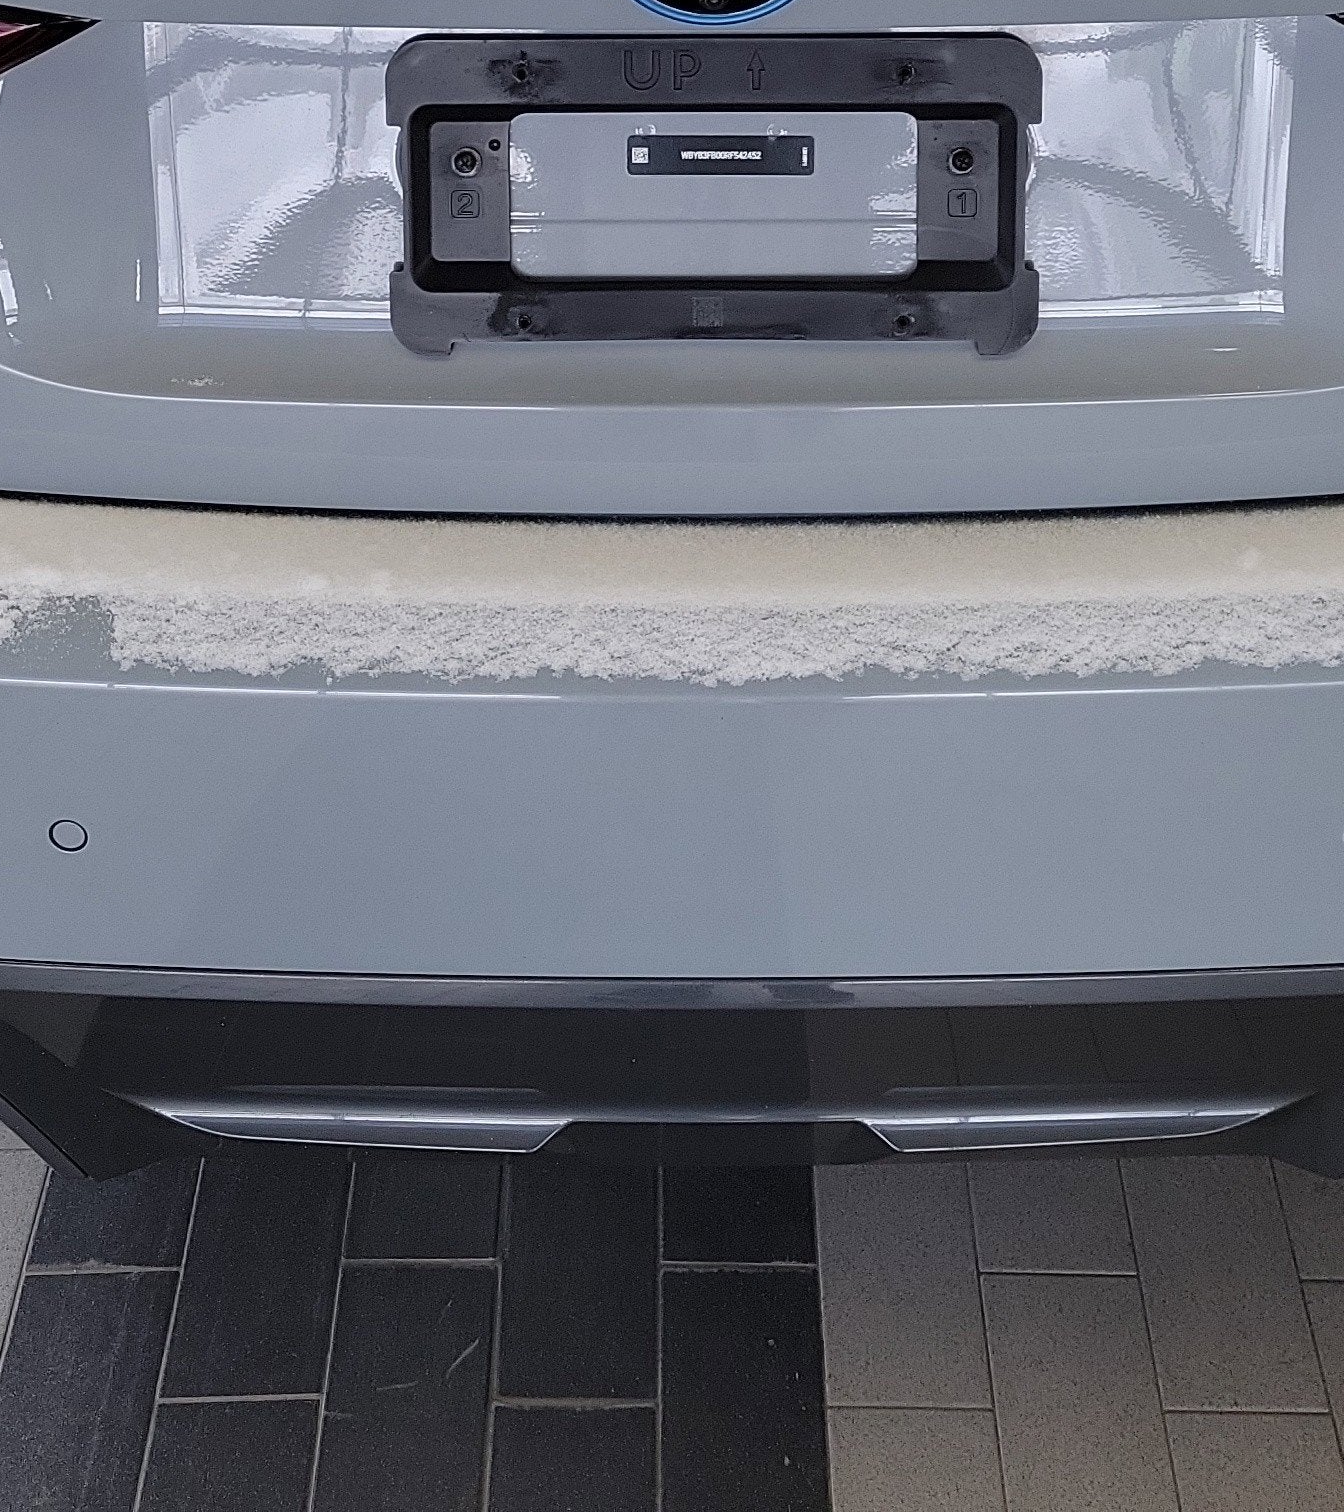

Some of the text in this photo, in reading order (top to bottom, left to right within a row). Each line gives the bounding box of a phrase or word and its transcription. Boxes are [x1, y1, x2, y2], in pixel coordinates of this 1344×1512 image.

[624, 50, 702, 90] UP
[458, 193, 474, 215] 2
[957, 192, 967, 214] 1
